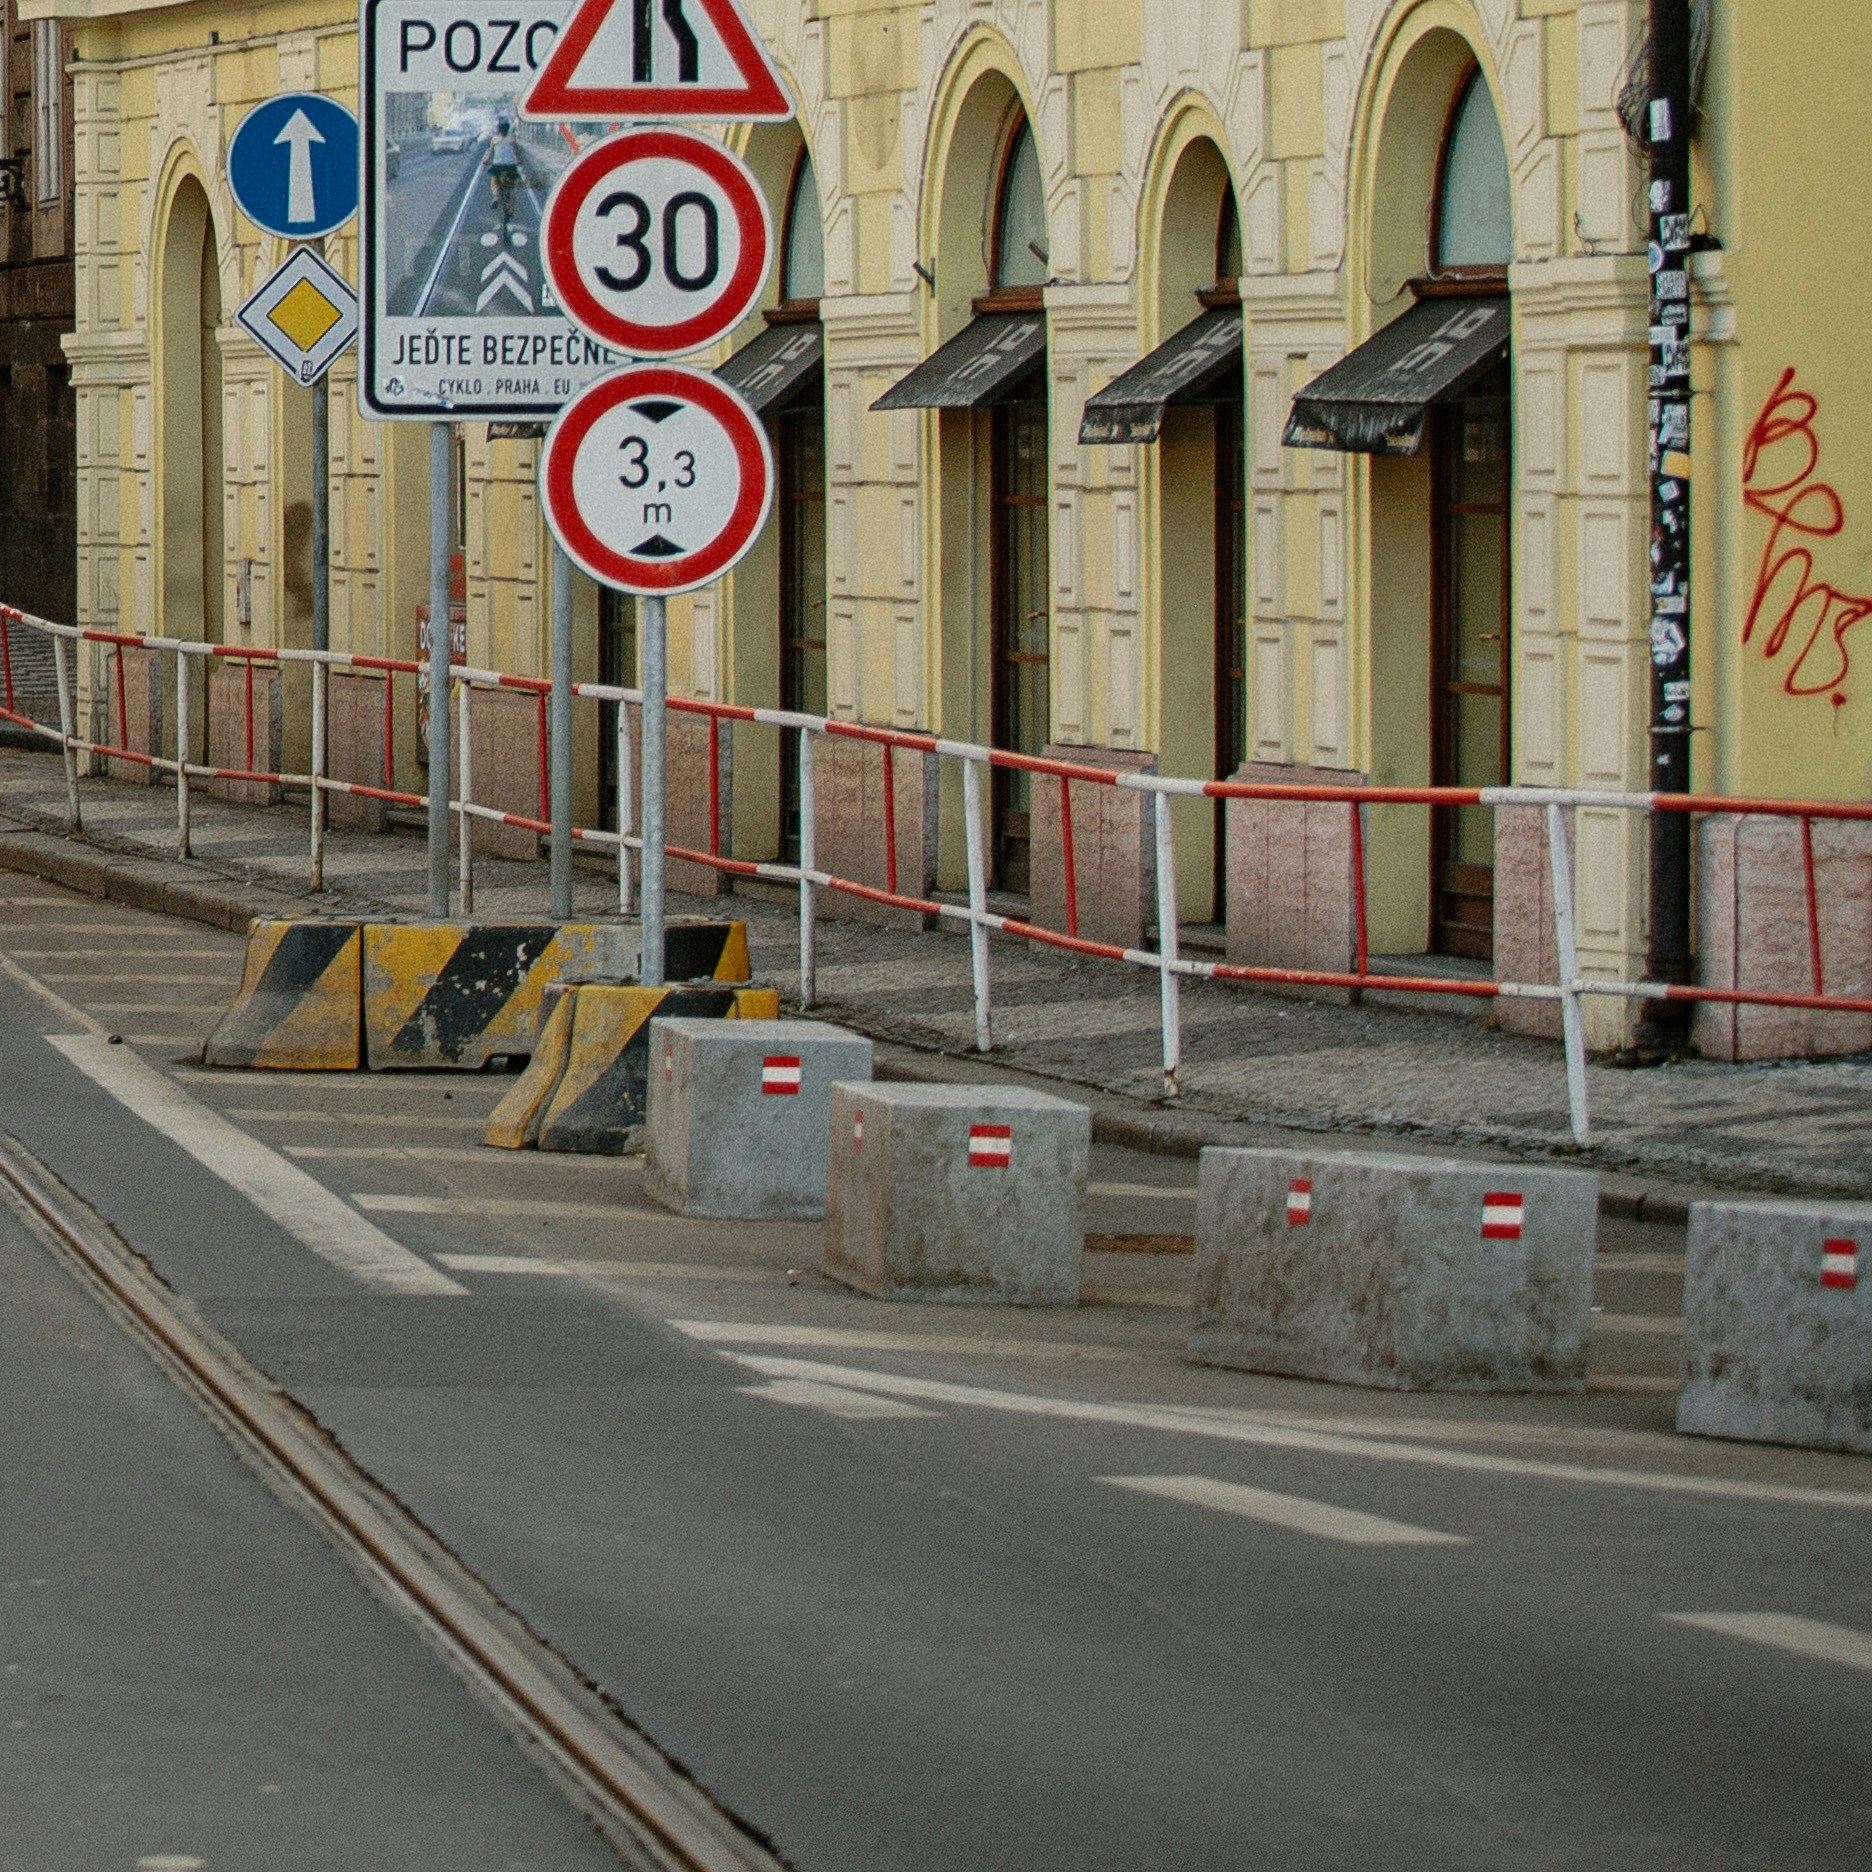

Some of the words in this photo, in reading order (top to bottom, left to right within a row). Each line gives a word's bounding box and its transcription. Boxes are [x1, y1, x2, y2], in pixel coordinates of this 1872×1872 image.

[400, 20, 558, 73] POZO
[594, 190, 719, 292] 30
[393, 328, 471, 365] JEĎTE
[617, 435, 697, 493] 3,3
[642, 500, 672, 524] m
